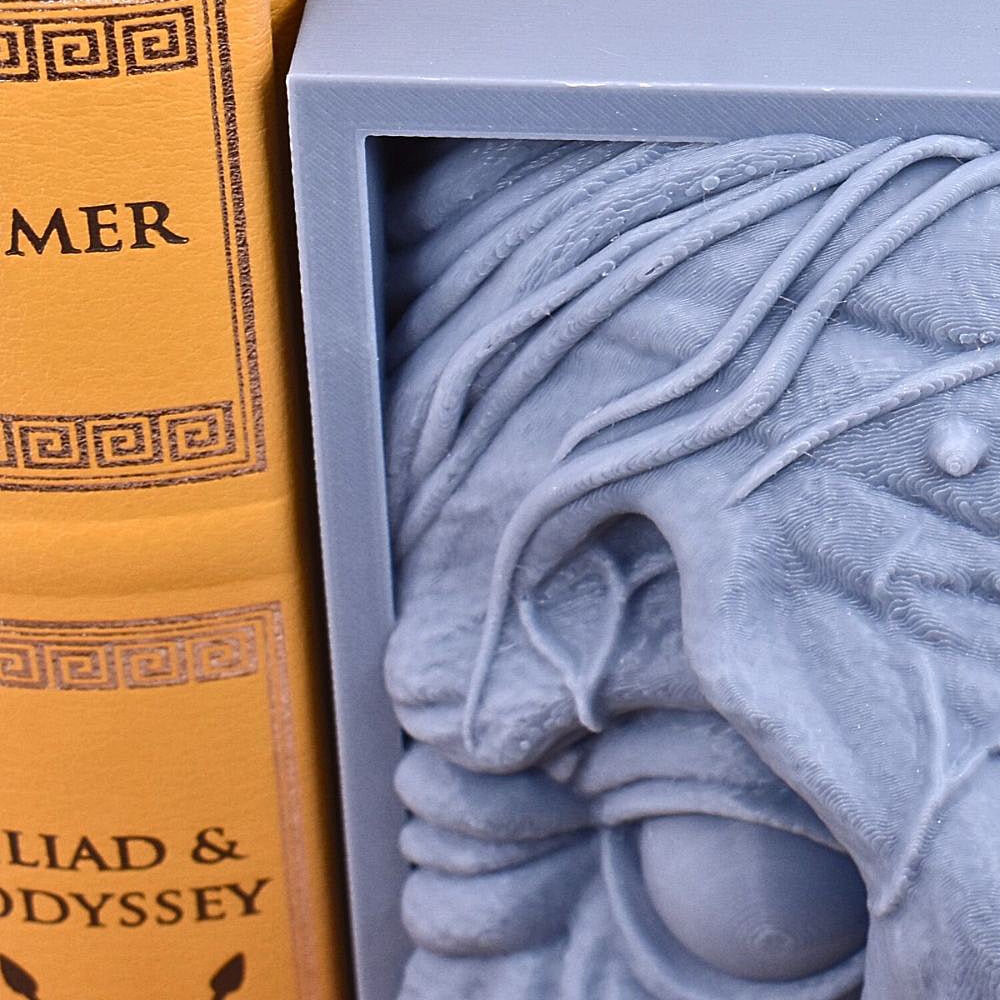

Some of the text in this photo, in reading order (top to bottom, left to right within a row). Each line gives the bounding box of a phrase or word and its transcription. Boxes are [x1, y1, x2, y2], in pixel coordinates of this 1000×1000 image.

[6, 200, 189, 256] MER
[3, 826, 248, 871] LIAD &
